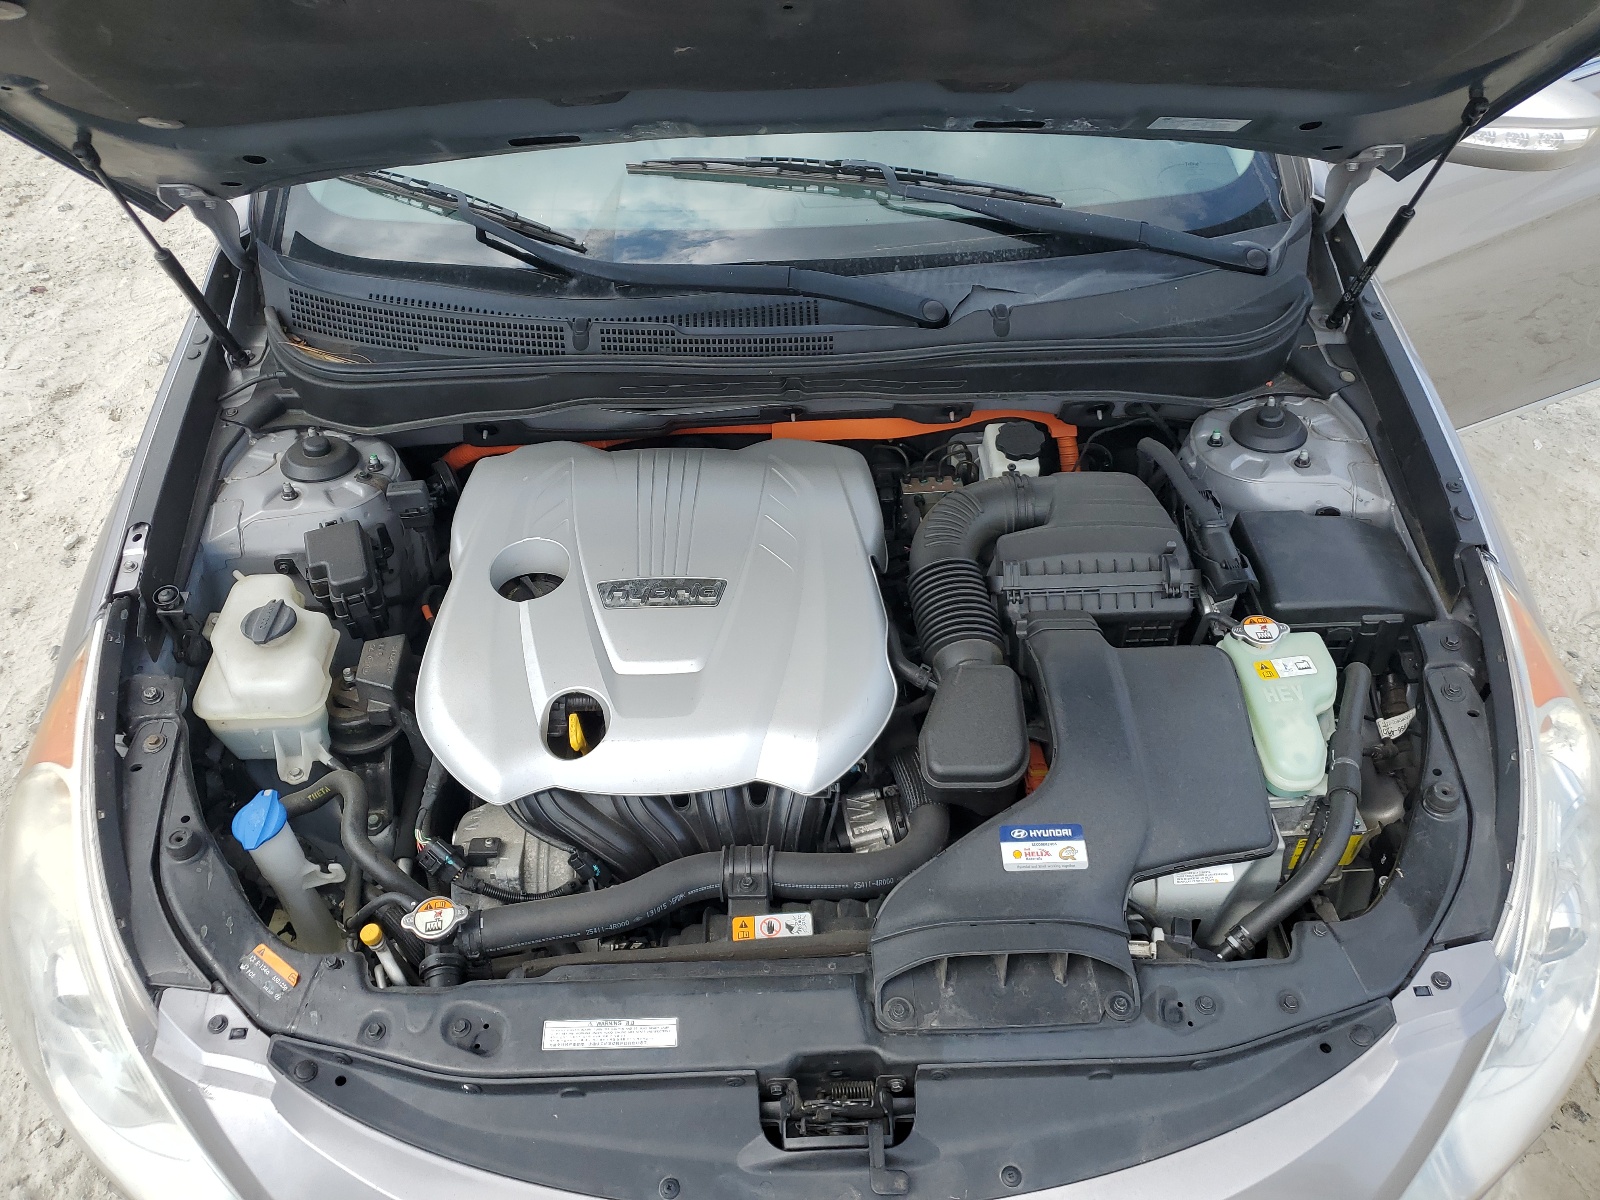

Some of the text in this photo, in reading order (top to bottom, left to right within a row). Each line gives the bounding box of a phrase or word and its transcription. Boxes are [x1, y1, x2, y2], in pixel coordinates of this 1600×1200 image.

[1262, 684, 1305, 703] HEV
[1029, 828, 1072, 838] HYUNDAI
[585, 919, 630, 936] 25411-4R000
